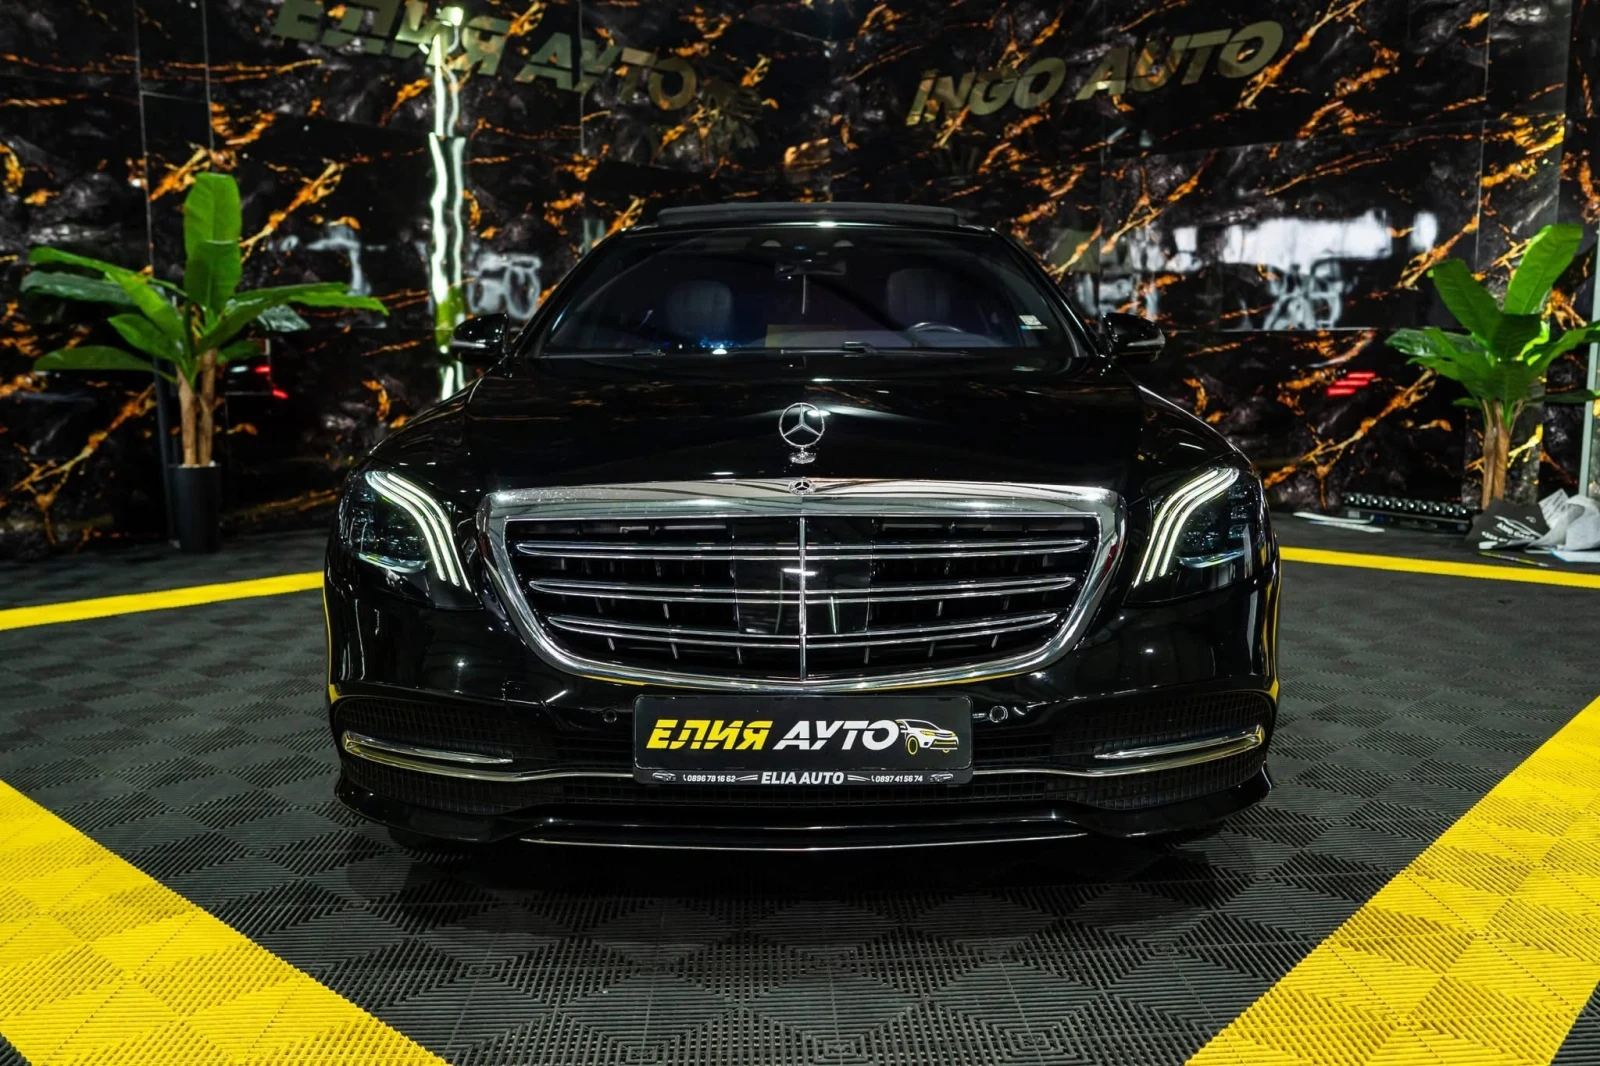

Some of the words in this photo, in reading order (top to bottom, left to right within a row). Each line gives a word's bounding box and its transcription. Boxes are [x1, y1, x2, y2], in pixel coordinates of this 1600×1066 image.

[514, 32, 698, 110] АУТО
[906, 56, 1067, 126] INGO
[1076, 20, 1284, 101] AUTO
[646, 719, 774, 750] ЕЛИЯ
[772, 720, 900, 751] АУТО
[761, 771, 797, 785] ELIA
[799, 771, 845, 785] AUTO
